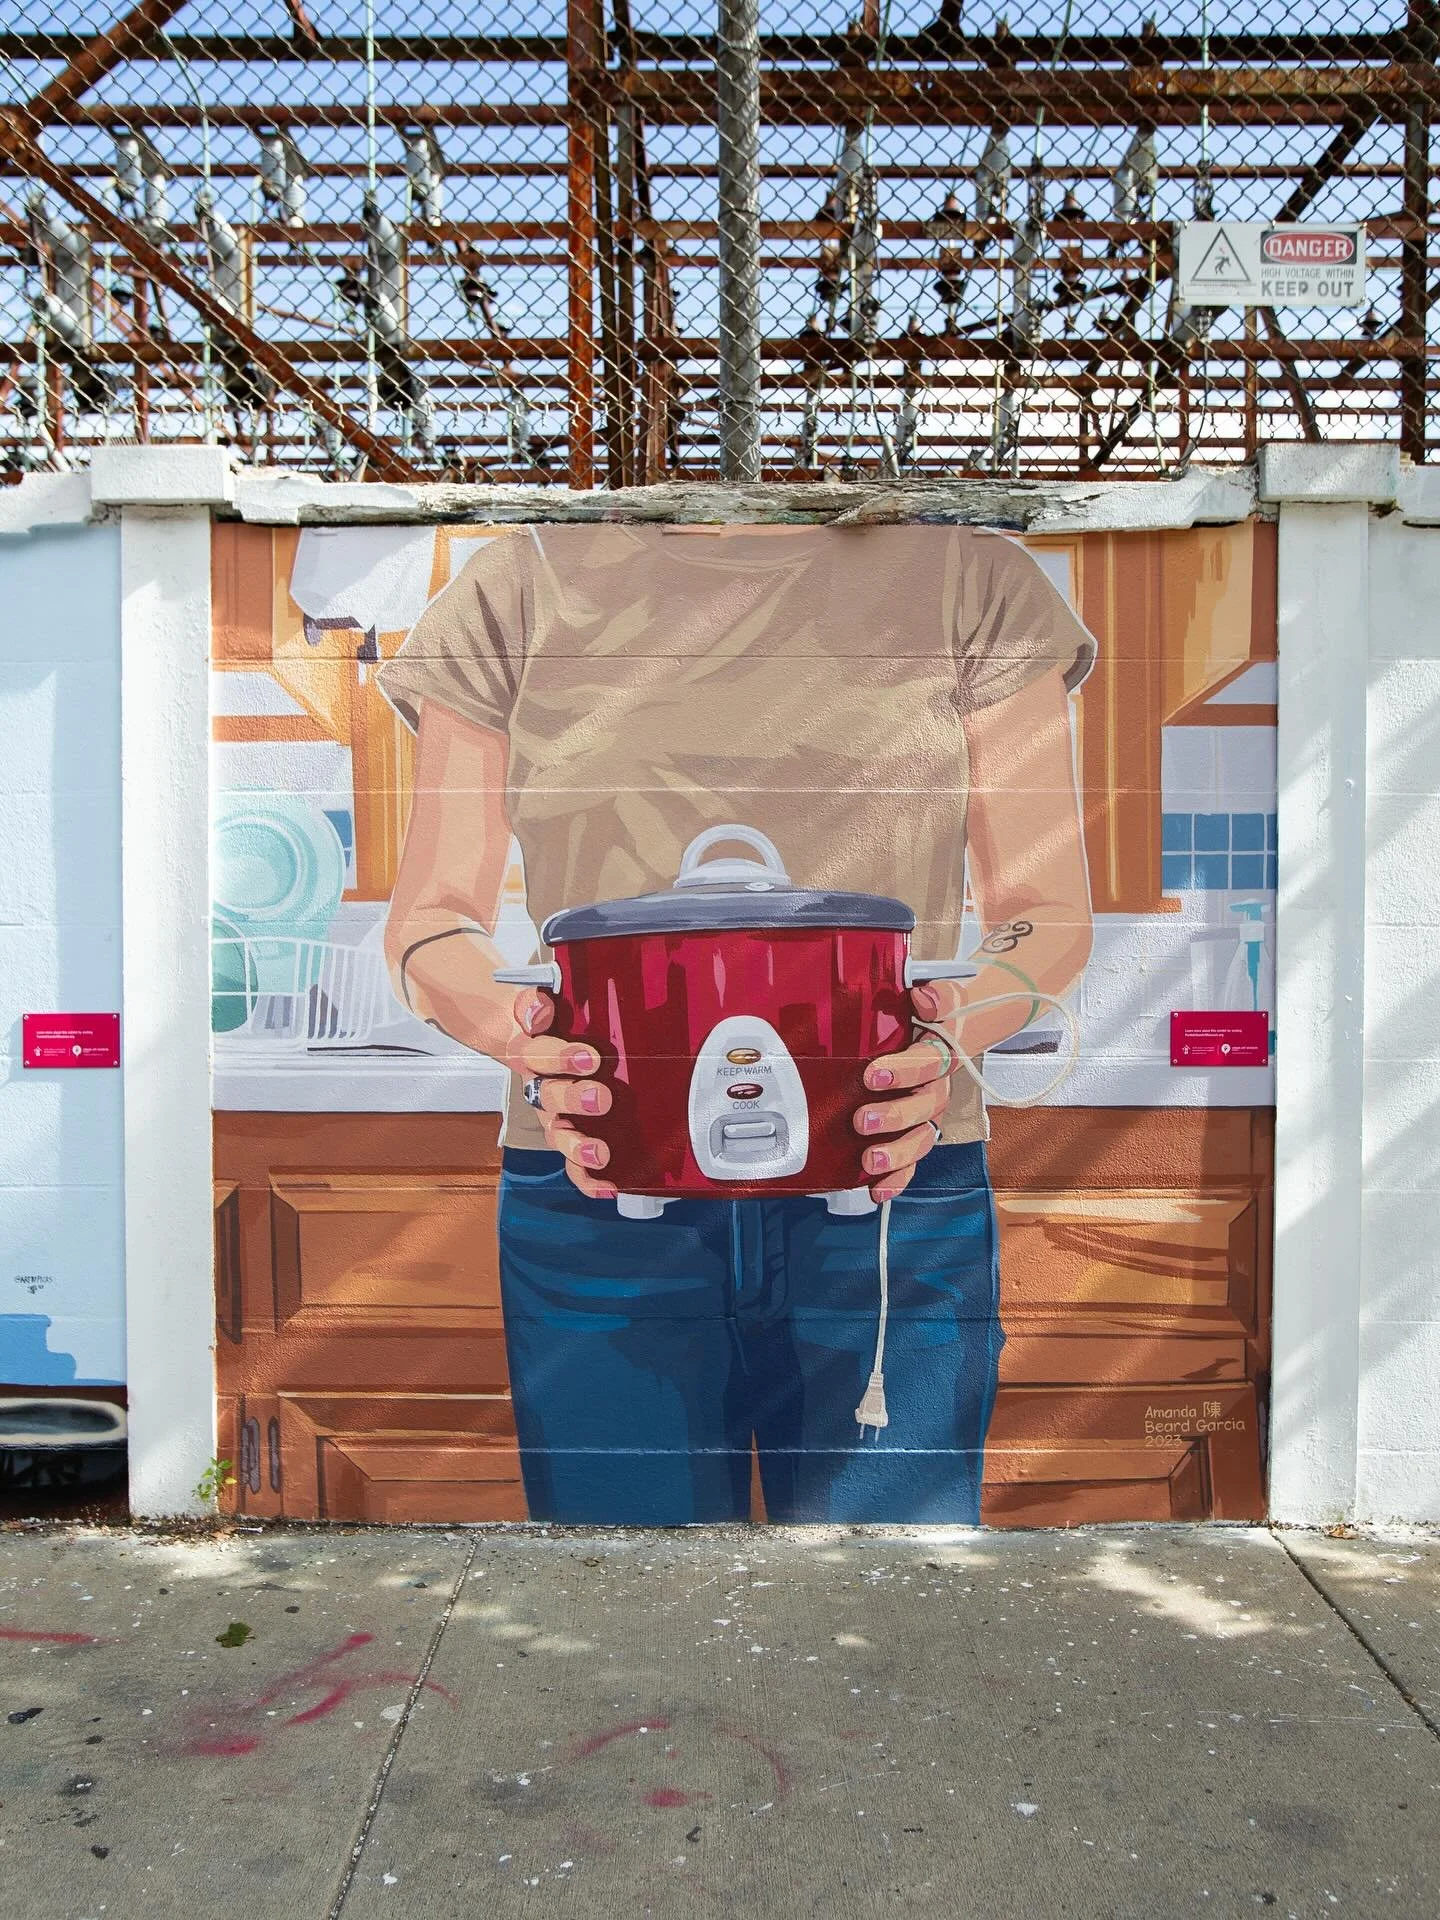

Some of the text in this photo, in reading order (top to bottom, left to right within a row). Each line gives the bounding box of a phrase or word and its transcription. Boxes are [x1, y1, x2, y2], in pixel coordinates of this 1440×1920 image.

[1269, 239, 1348, 257] DANGER
[1261, 268, 1355, 278] HIGH VOLTAGE WITHIN
[1261, 281, 1354, 297] KEEP OUT
[716, 1066, 772, 1076] KEEP WARM
[732, 1101, 760, 1110] COOK
[1144, 1401, 1221, 1419] Amanda 陳
[1144, 1417, 1246, 1434] Beard Garcia
[1145, 1435, 1183, 1447] 2023
